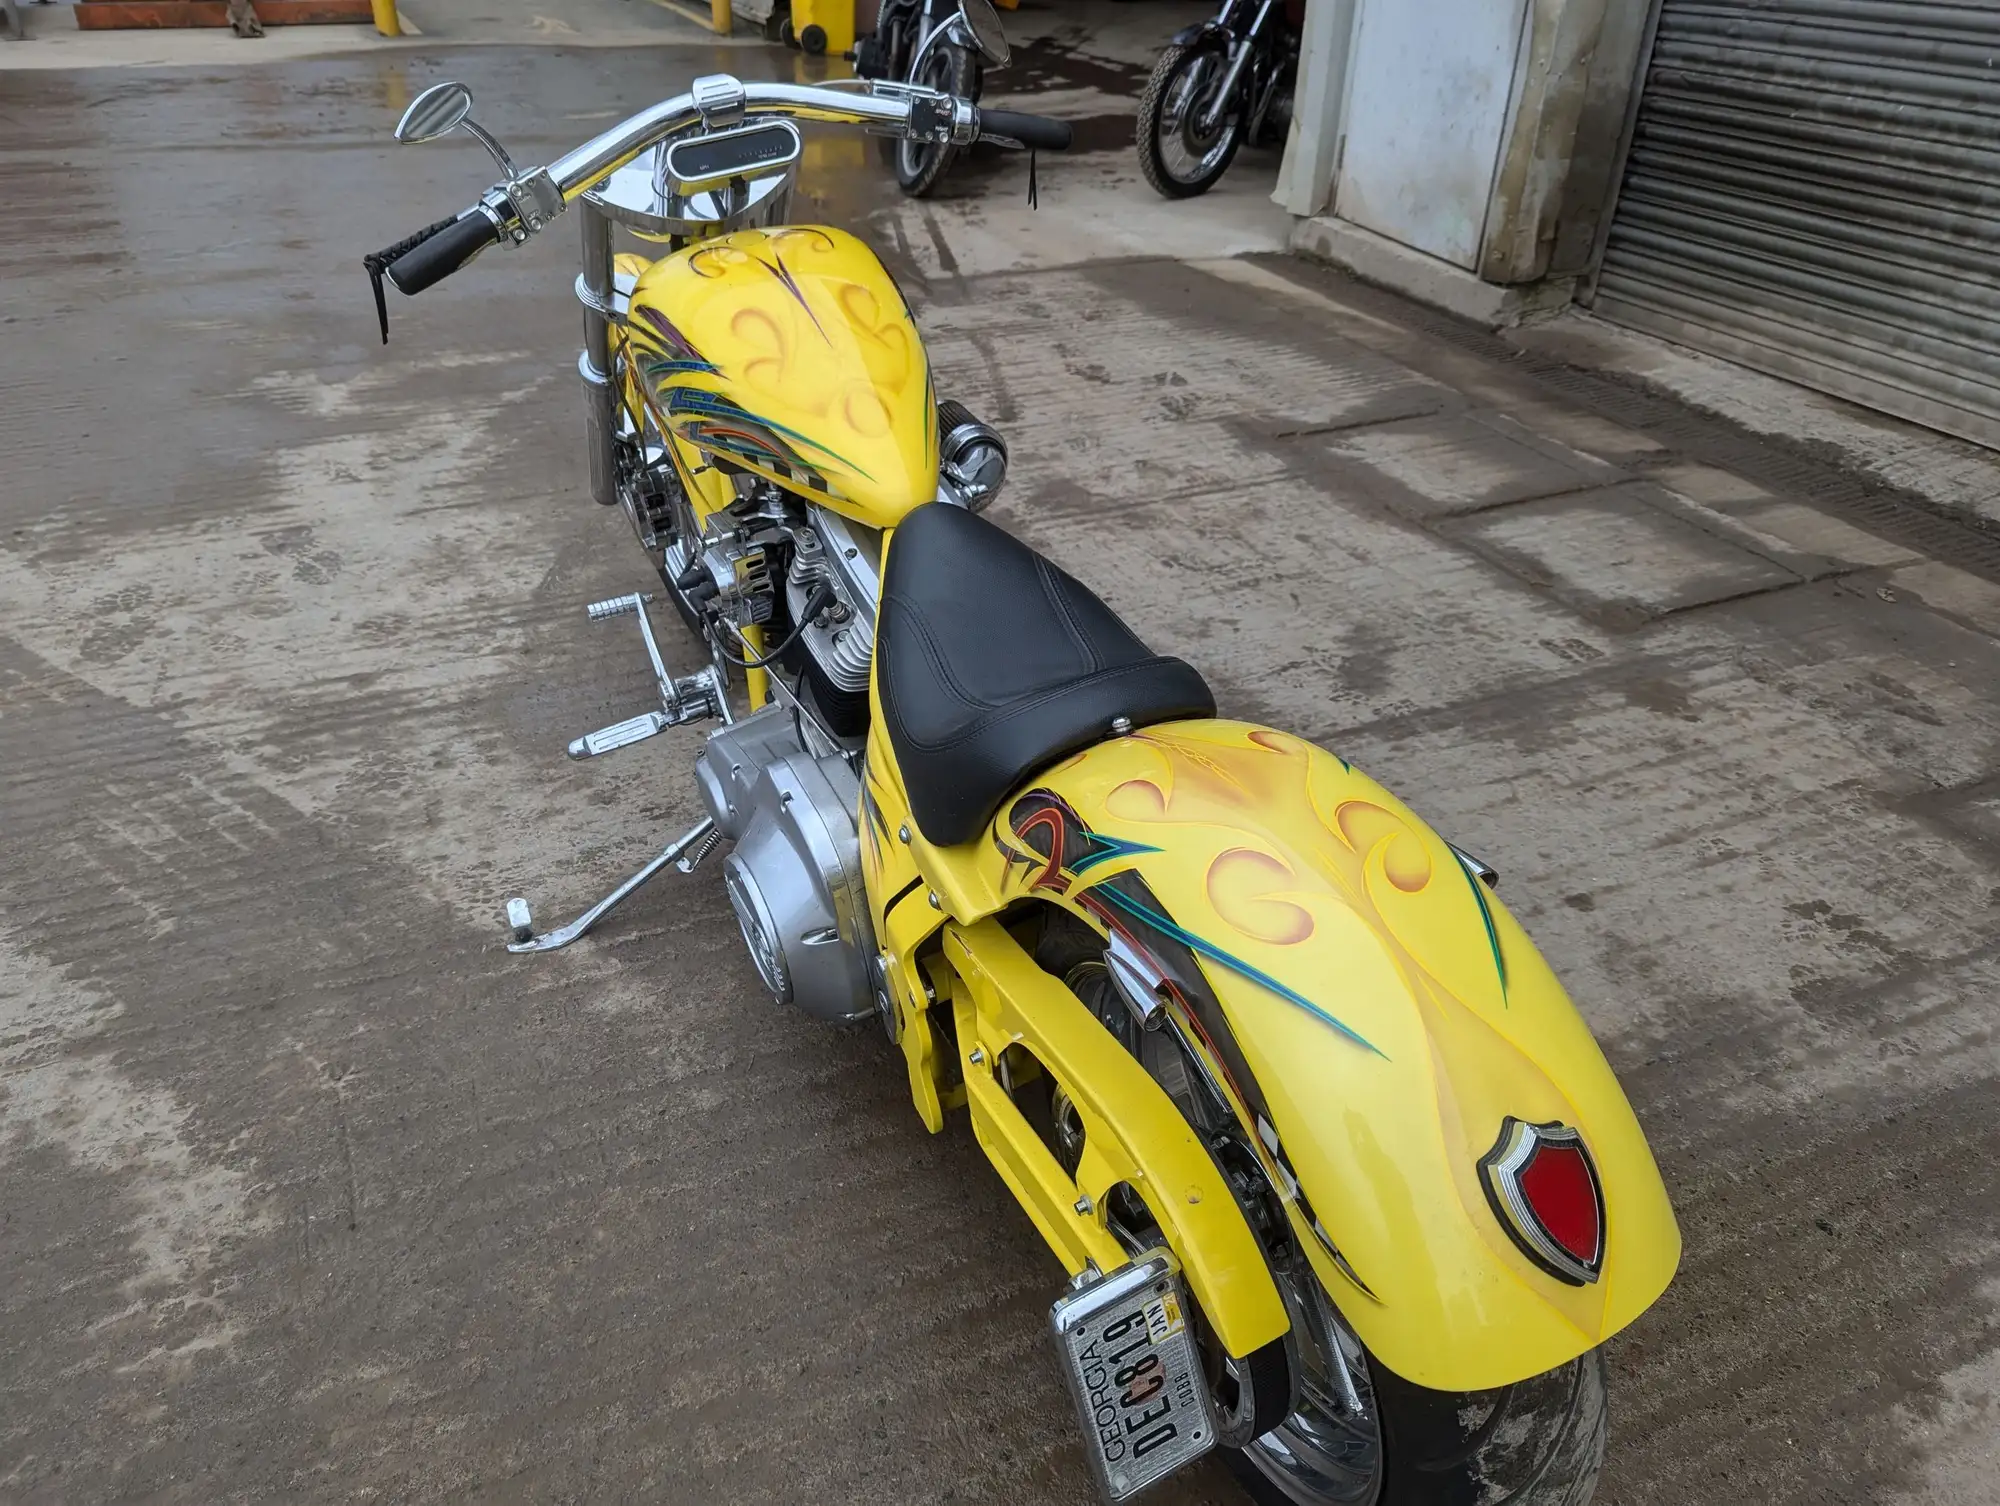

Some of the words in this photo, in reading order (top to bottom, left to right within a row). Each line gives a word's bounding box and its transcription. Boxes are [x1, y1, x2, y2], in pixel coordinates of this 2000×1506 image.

[1146, 1303, 1168, 1338] JAN
[1080, 1338, 1126, 1462] GEORGIA
[1102, 1309, 1178, 1459] DEC819
[1174, 1371, 1195, 1408] COBB
